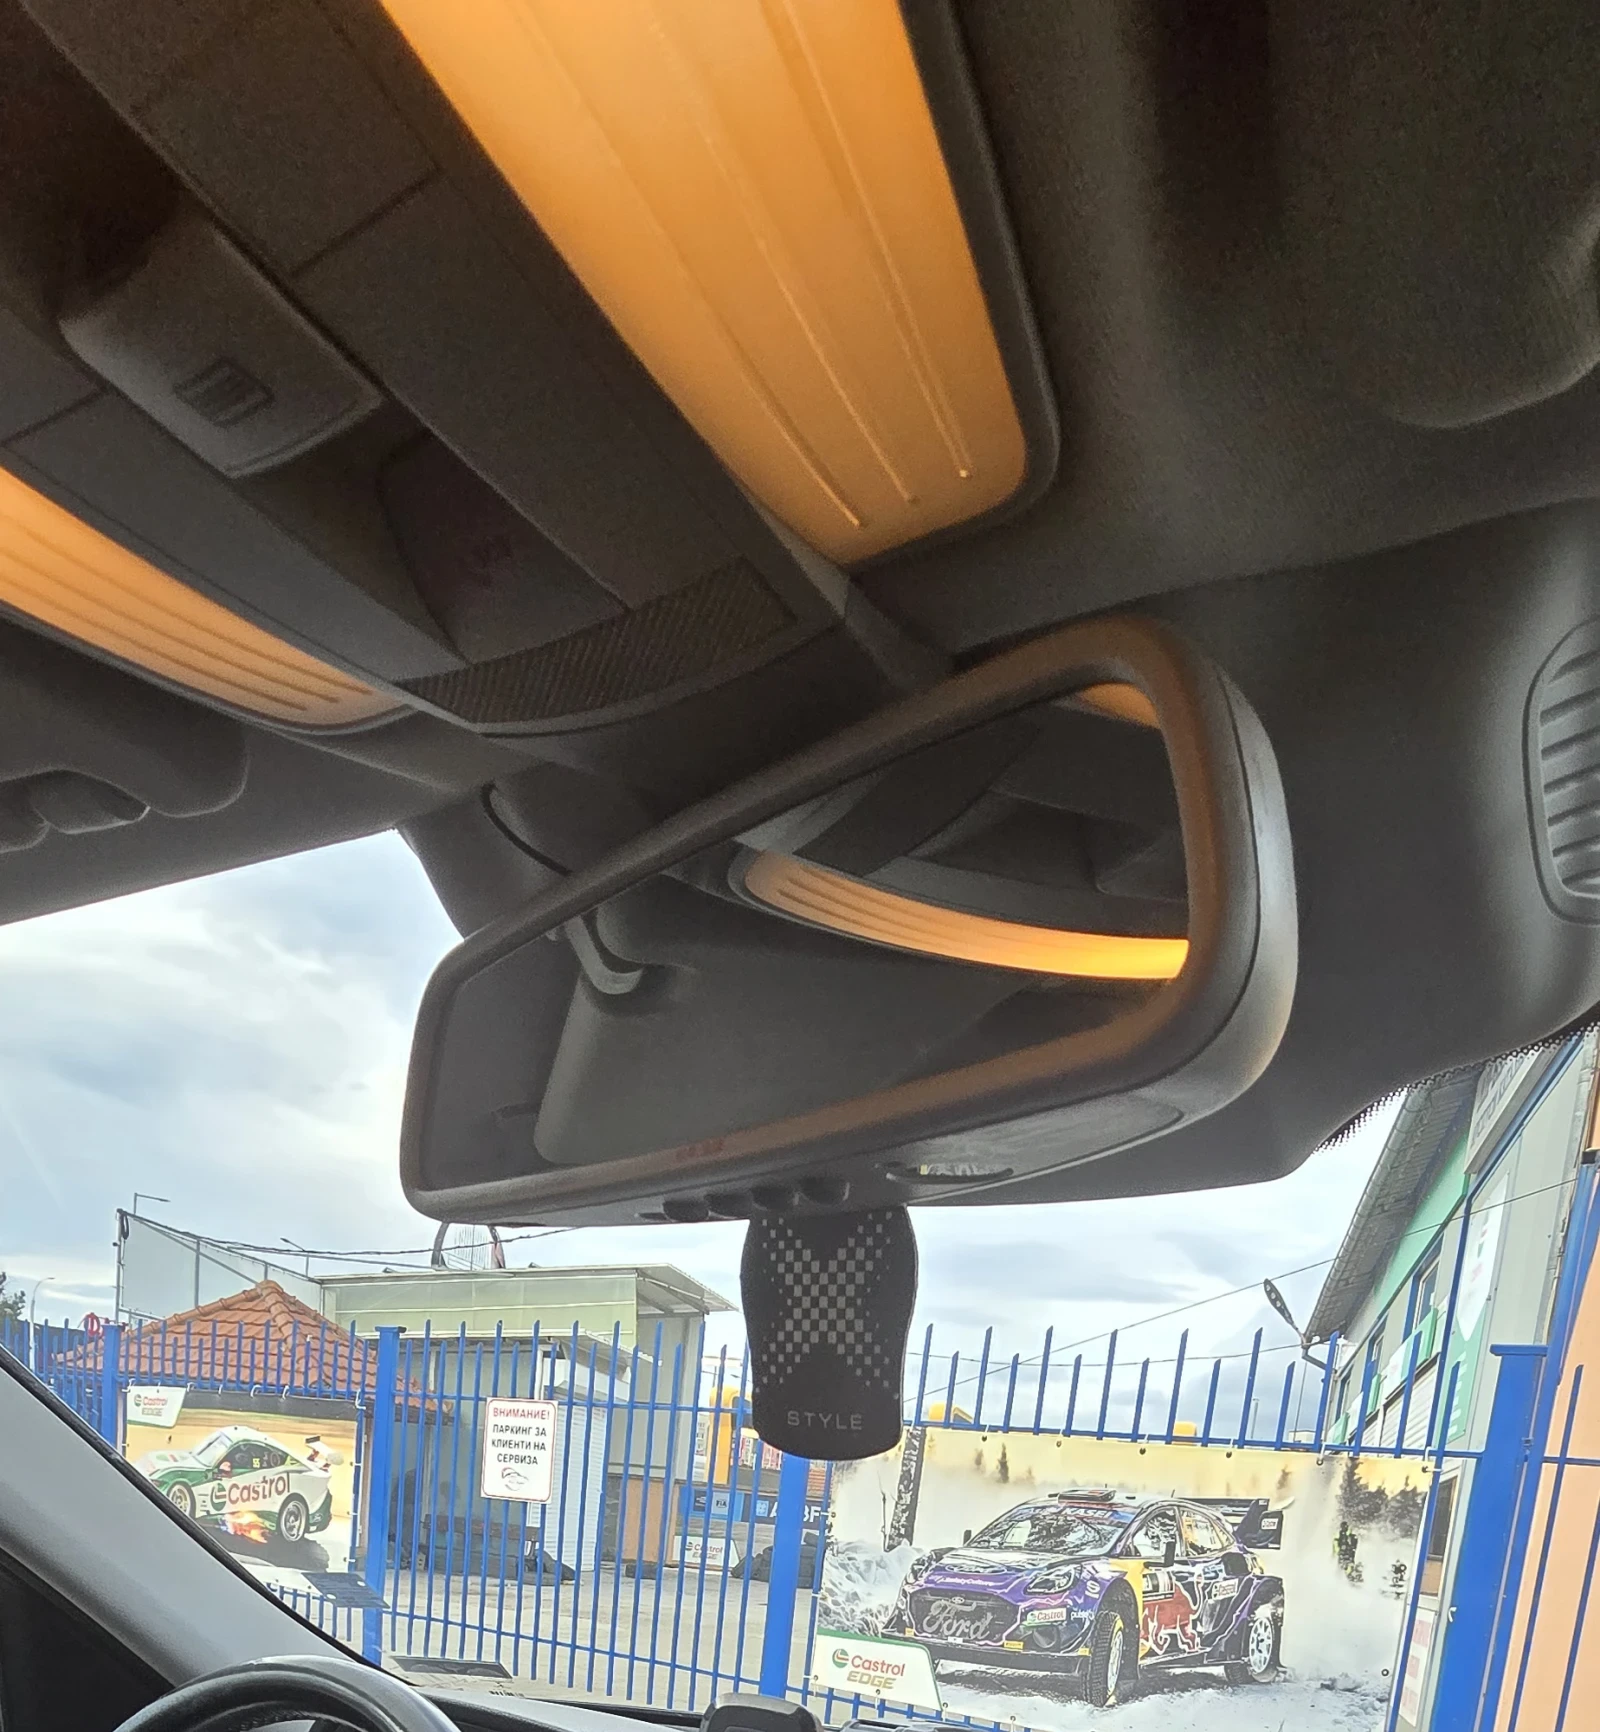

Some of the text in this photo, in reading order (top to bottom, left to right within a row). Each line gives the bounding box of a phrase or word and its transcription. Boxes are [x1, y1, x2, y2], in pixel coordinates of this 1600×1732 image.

[493, 1407, 550, 1420] ВНИМАНИЕ!
[787, 1411, 863, 1430] STYLE
[492, 1424, 547, 1437] ПАРКИНГ ЗА
[491, 1439, 547, 1451] КЛИЕНТИ НА
[497, 1453, 538, 1465] СЕРВИЗА
[228, 1472, 290, 1505] Castrol
[923, 1601, 993, 1641] Ford
[1037, 1611, 1065, 1621] Castrol
[851, 1655, 906, 1677] Castrol
[847, 1671, 897, 1689] EDGE
